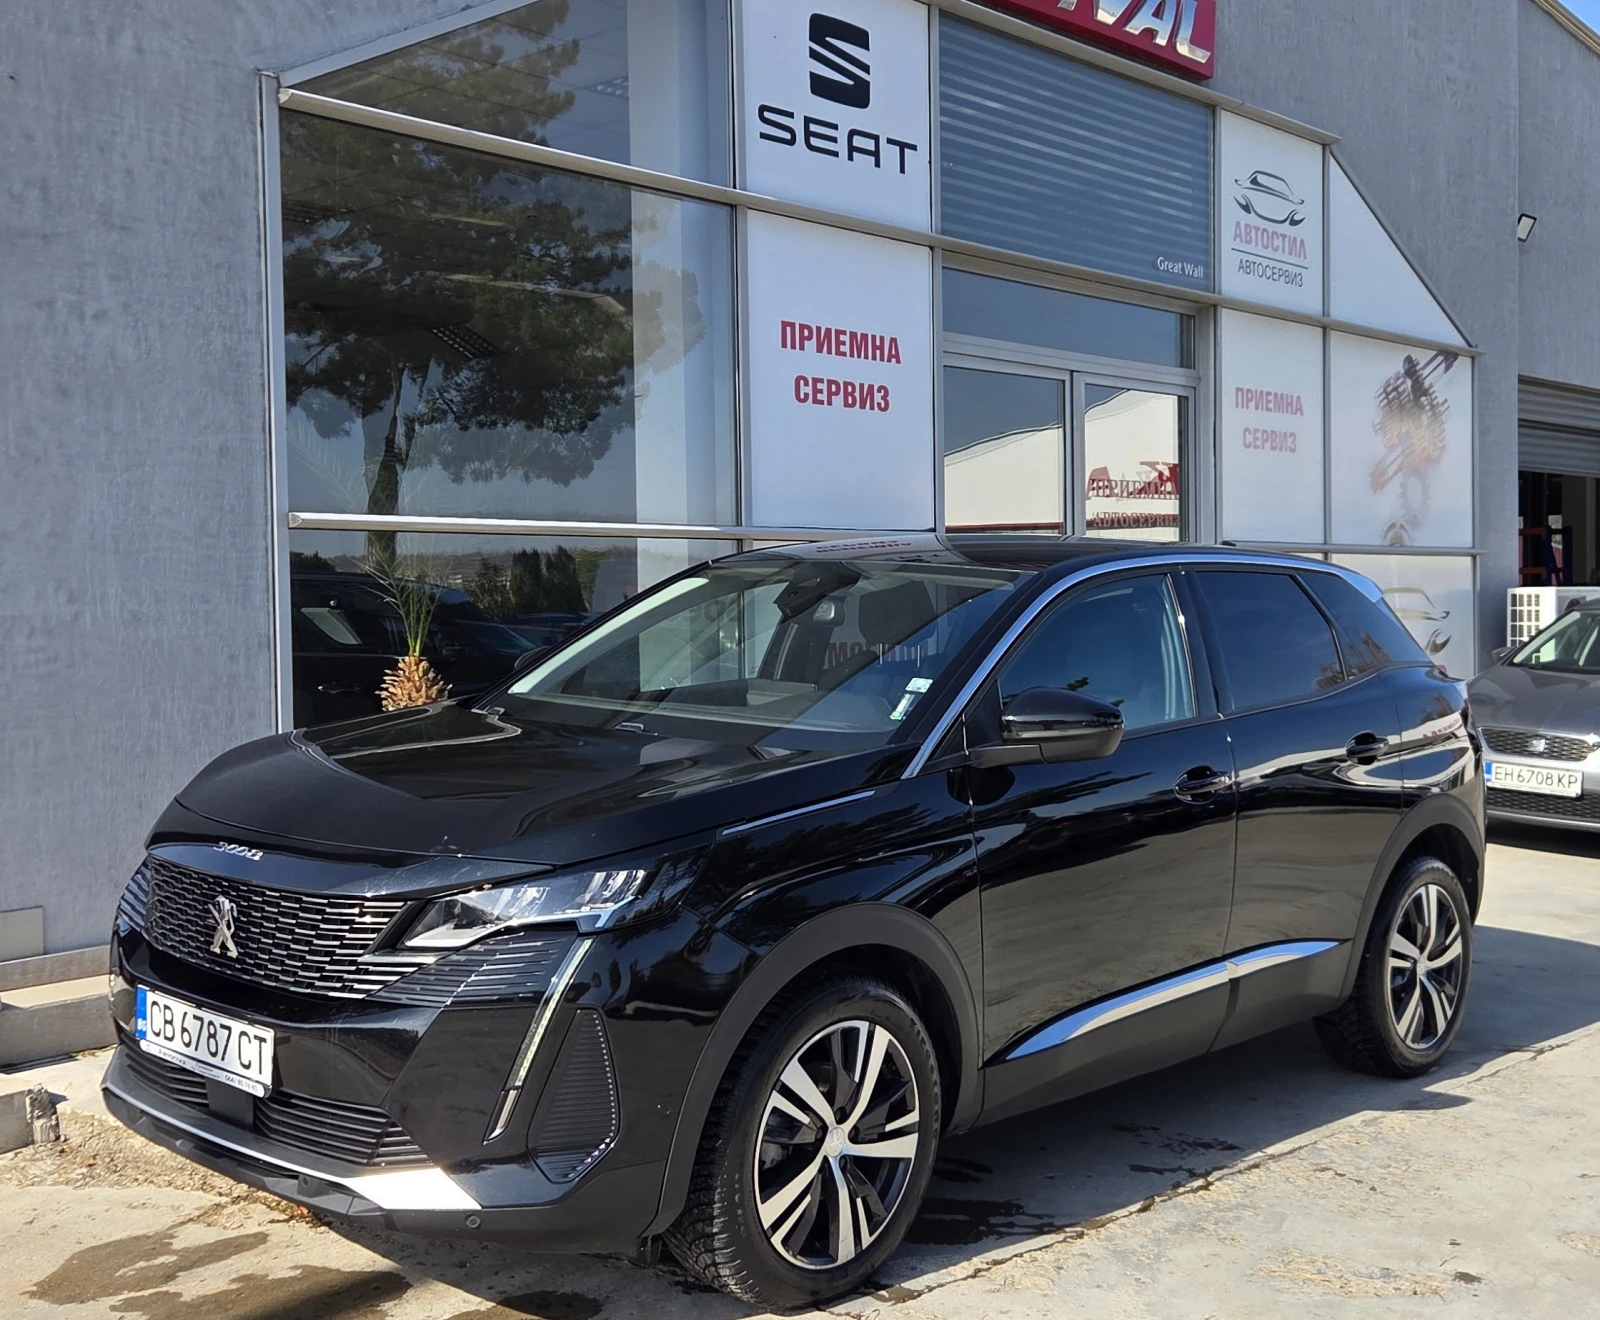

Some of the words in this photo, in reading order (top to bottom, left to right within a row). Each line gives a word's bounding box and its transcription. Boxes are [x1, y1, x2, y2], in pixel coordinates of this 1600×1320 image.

[757, 104, 918, 174] SEAT
[1233, 220, 1307, 260] АВТОСТИЛ
[1157, 256, 1182, 275] Great
[1183, 262, 1204, 279] Wall
[1237, 258, 1304, 288] АВТОСЕРВИЗ
[780, 320, 901, 364] ПРИЕМНА
[794, 374, 890, 412] СЕРВИЗ
[1235, 386, 1304, 417] ПРИЕМНА
[1242, 427, 1297, 453] СЕРВИЗ
